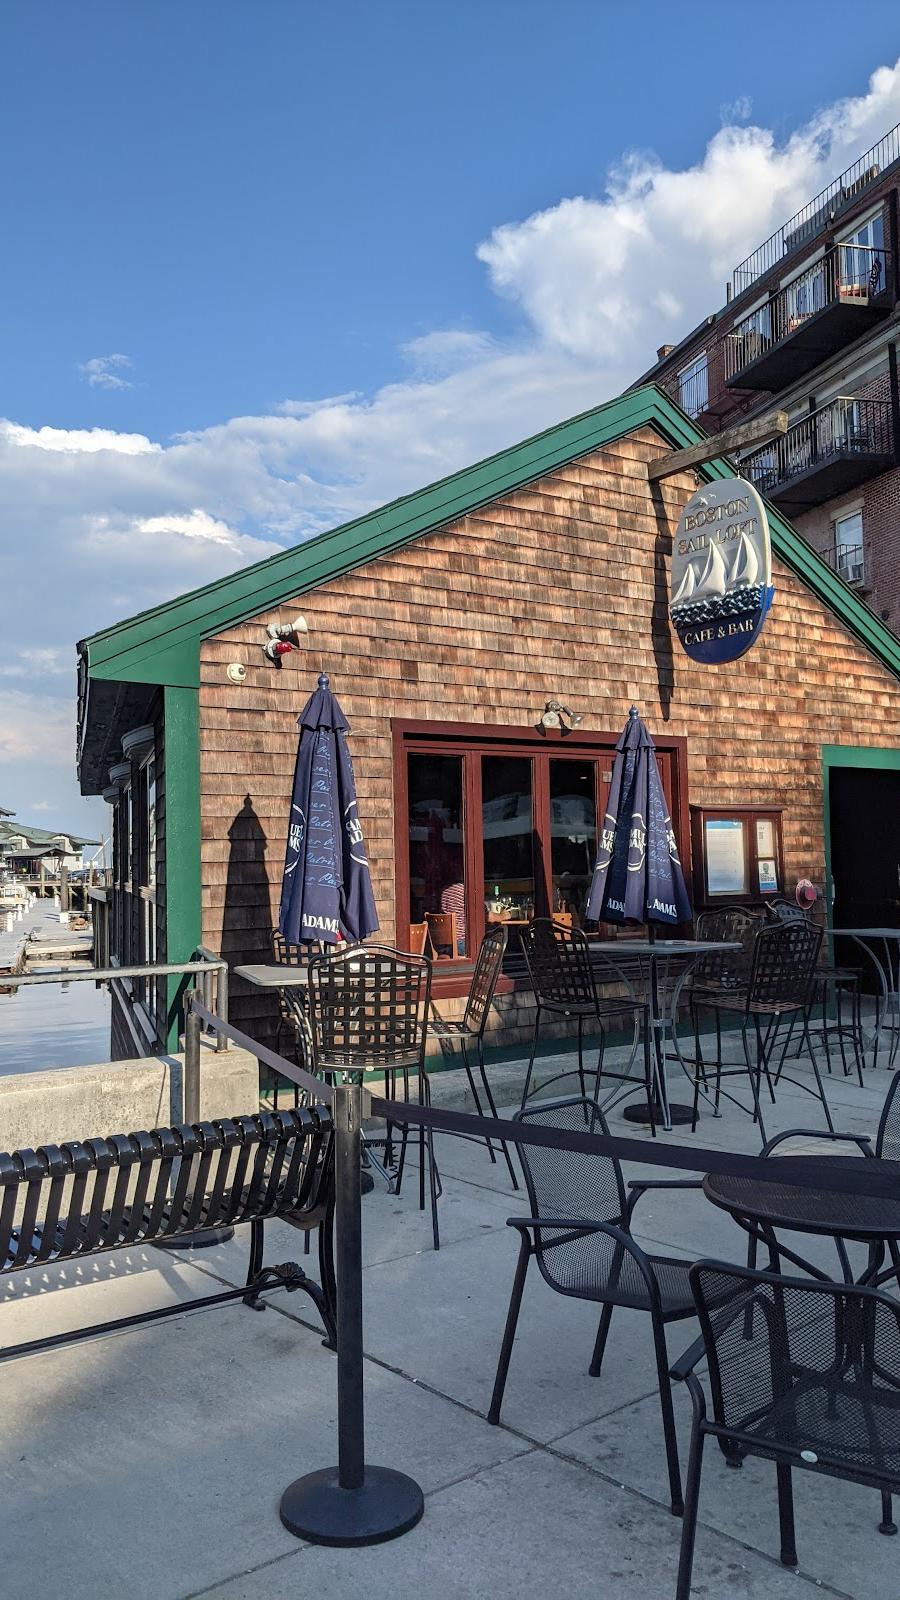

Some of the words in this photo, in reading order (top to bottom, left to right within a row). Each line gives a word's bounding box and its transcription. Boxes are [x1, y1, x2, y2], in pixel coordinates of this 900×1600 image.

[685, 496, 750, 532] BOSTON
[678, 534, 710, 555] SAIL
[716, 518, 758, 544] LOFT
[684, 628, 714, 645] CAFE
[717, 626, 726, 638] &
[728, 619, 754, 635] BAR
[606, 898, 626, 913] ADA
